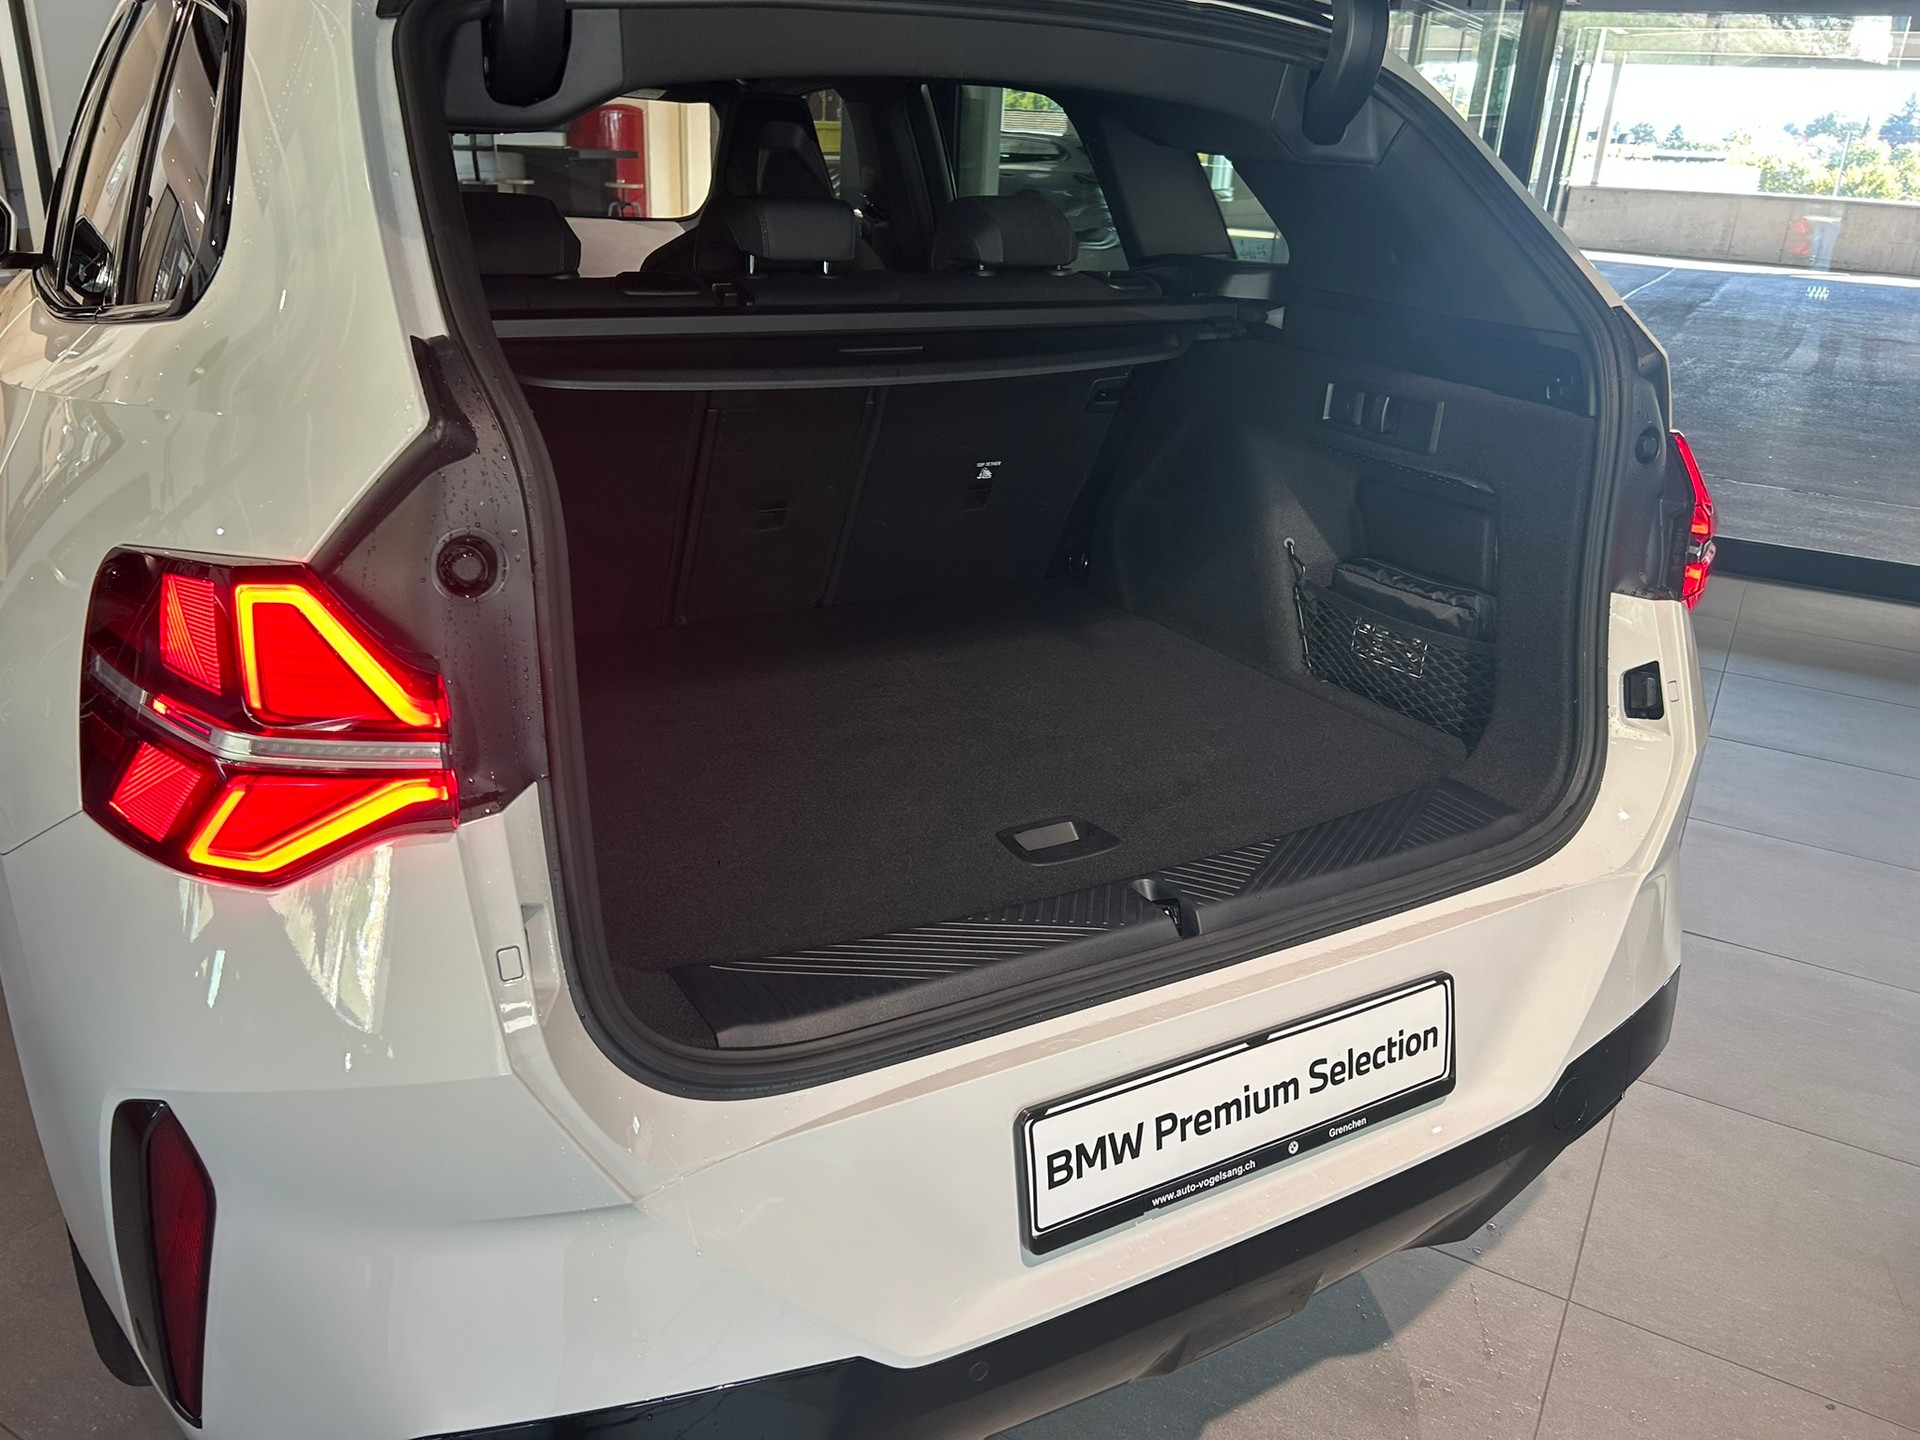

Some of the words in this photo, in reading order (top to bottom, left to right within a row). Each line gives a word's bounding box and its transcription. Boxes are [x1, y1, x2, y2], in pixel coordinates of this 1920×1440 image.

[1047, 1122, 1144, 1190] BMW
[1155, 1076, 1300, 1151] Premium
[1308, 1025, 1438, 1095] Selection
[1328, 1116, 1367, 1138] Grenchen
[1151, 1158, 1256, 1207] www.auto-vogelsang.ch
